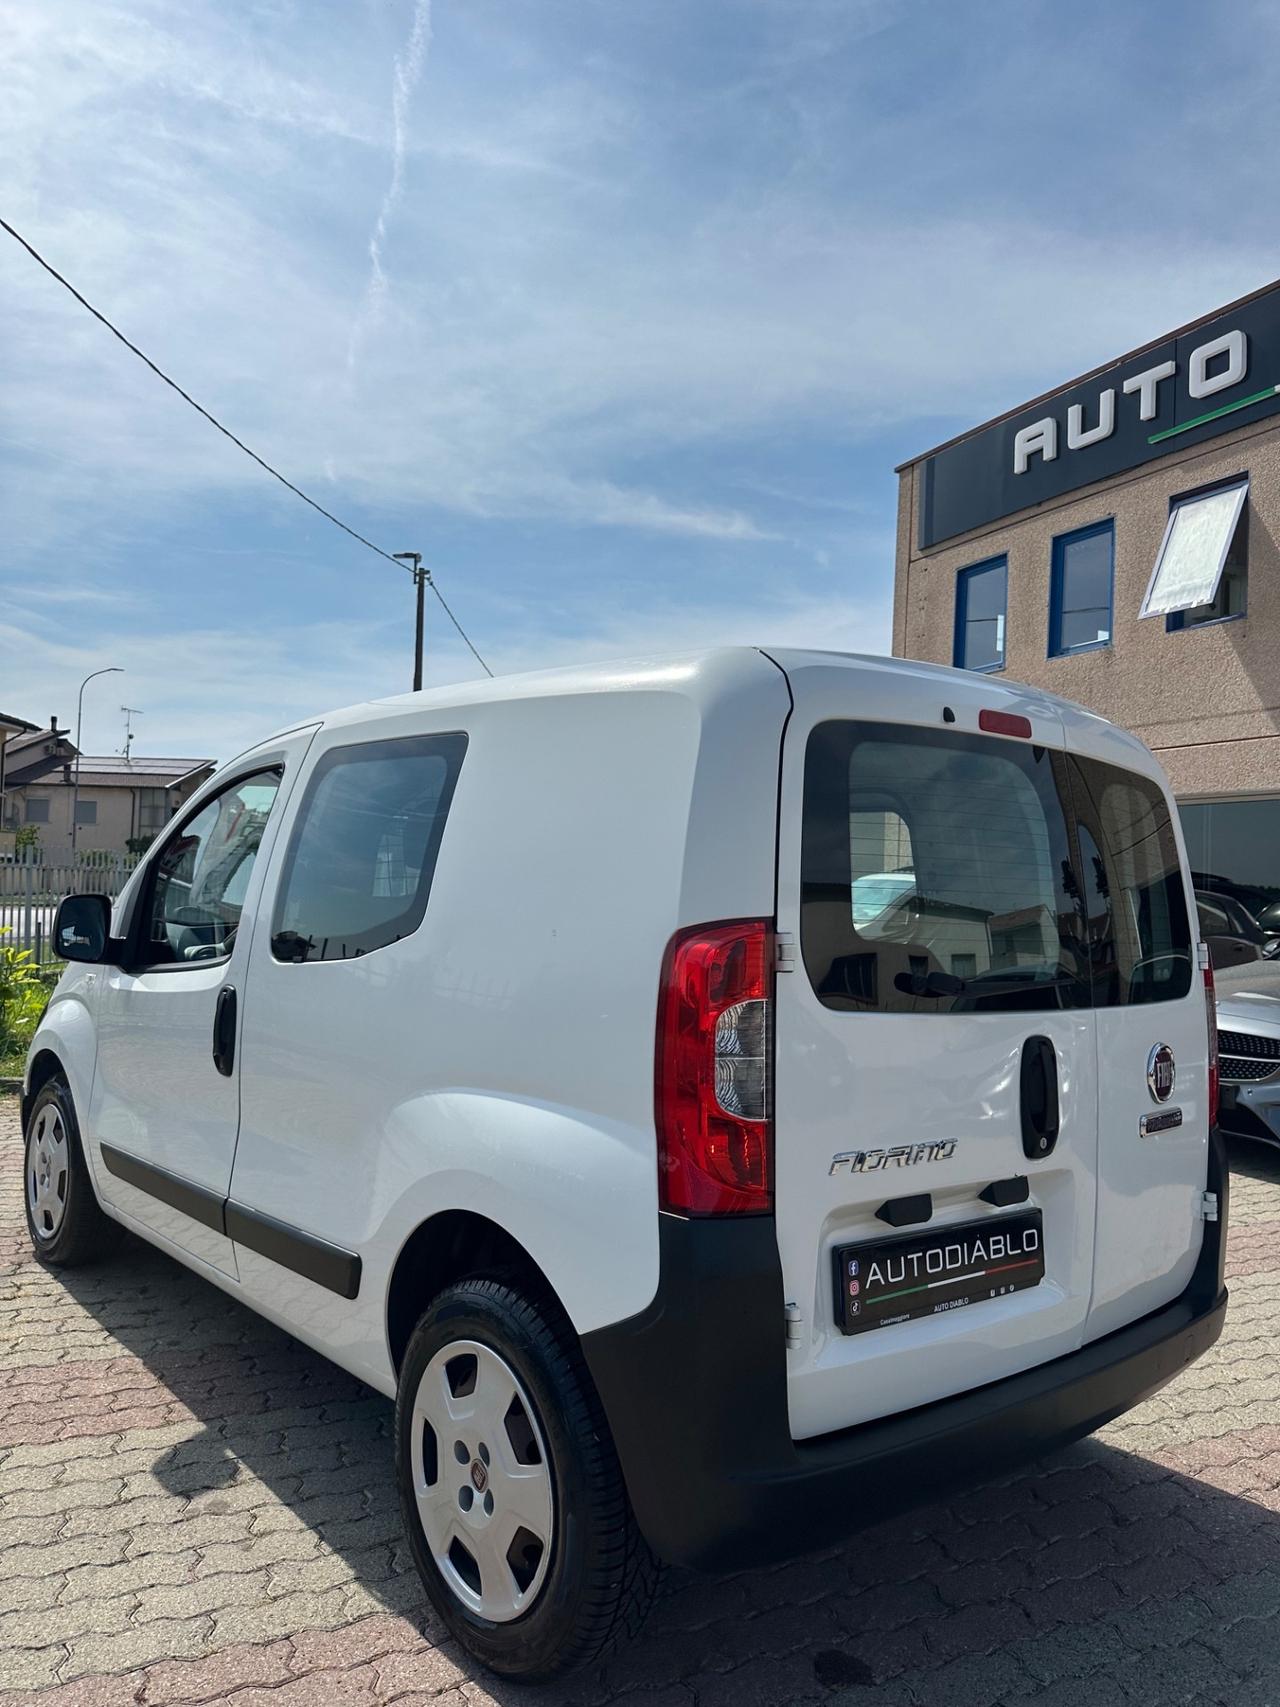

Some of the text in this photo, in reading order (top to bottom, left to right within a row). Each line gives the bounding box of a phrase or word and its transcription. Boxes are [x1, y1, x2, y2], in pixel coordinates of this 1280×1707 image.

[1014, 329, 1248, 475] AUTO
[828, 1137, 958, 1176] FIORINO
[865, 1228, 1038, 1290] AUTODIABLO
[934, 1297, 969, 1313] AUTO DIABLO
